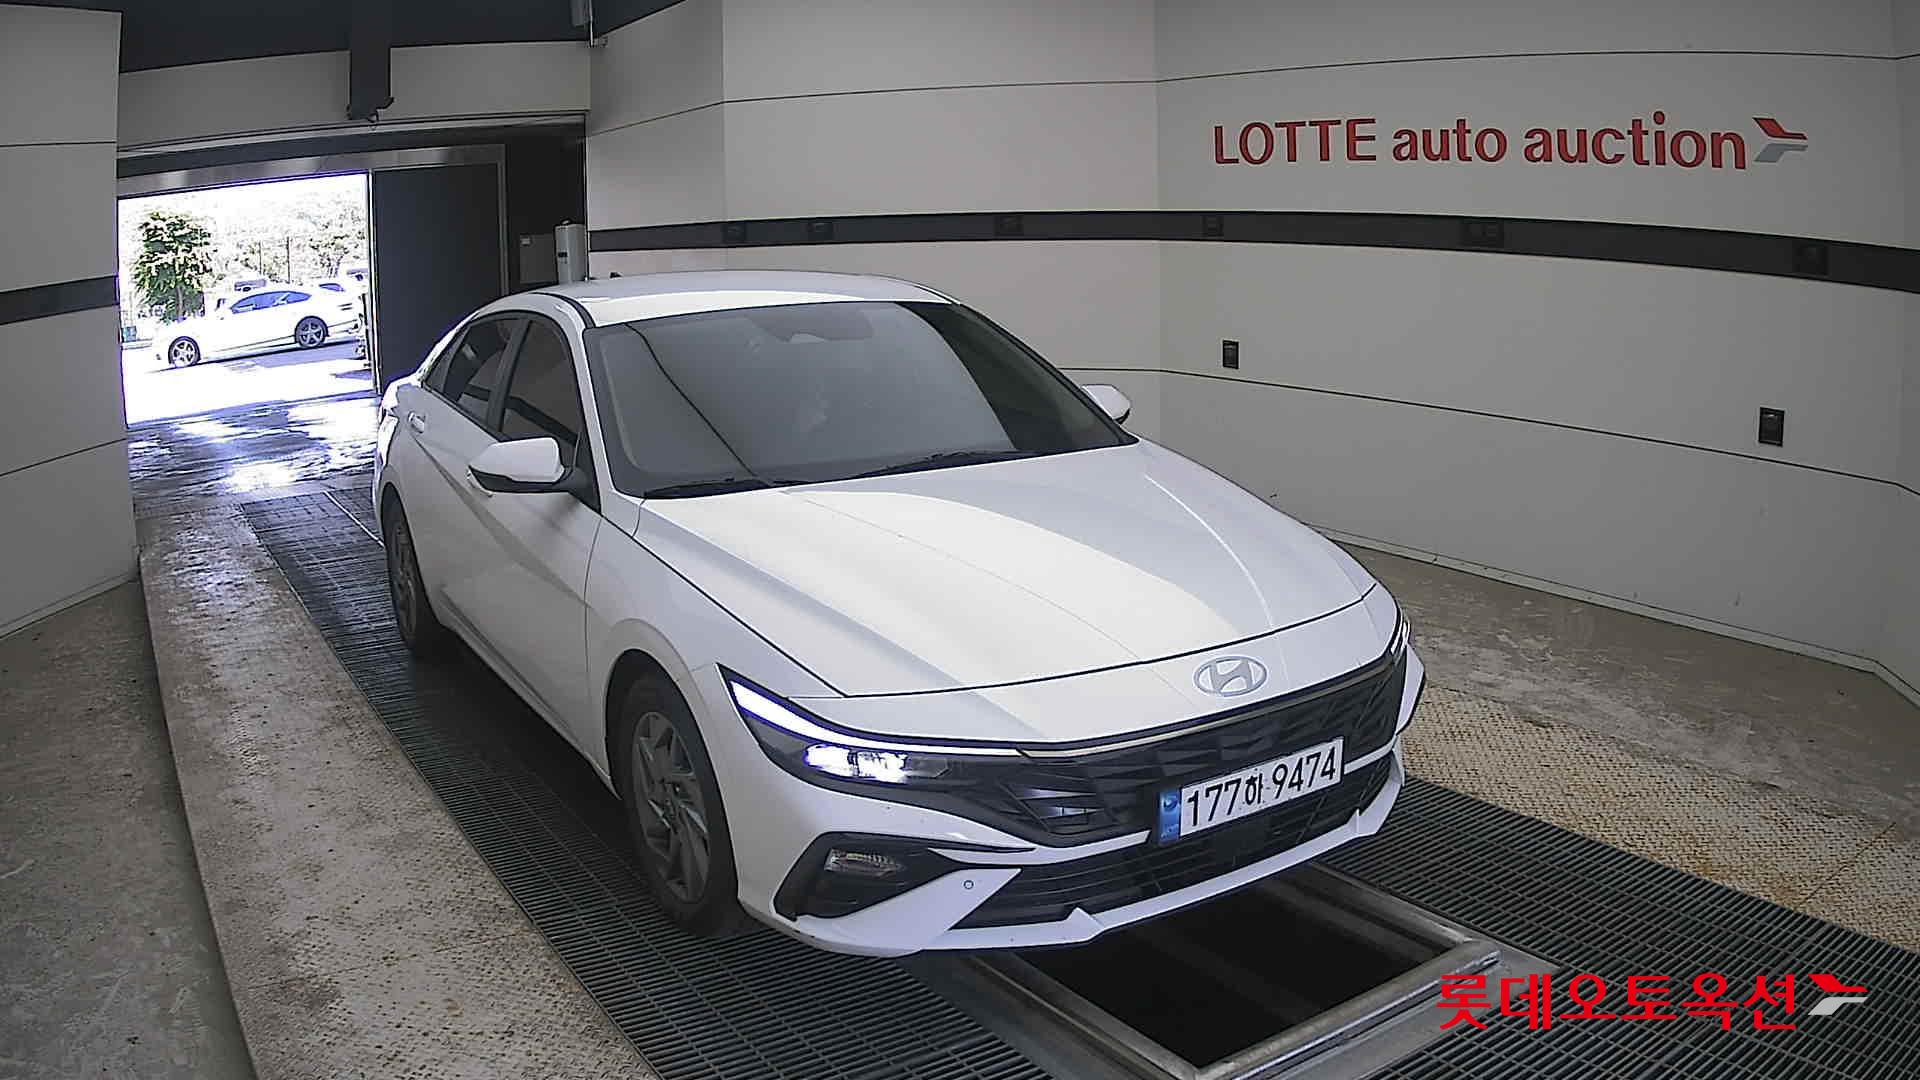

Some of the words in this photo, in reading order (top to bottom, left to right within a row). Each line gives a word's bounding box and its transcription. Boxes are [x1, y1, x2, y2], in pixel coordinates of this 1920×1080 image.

[1213, 117, 1377, 165] LOTTE
[1391, 118, 1508, 163] auto
[1523, 111, 1748, 170] auction
[1187, 773, 1264, 826] 177하
[1272, 746, 1336, 799] 9474
